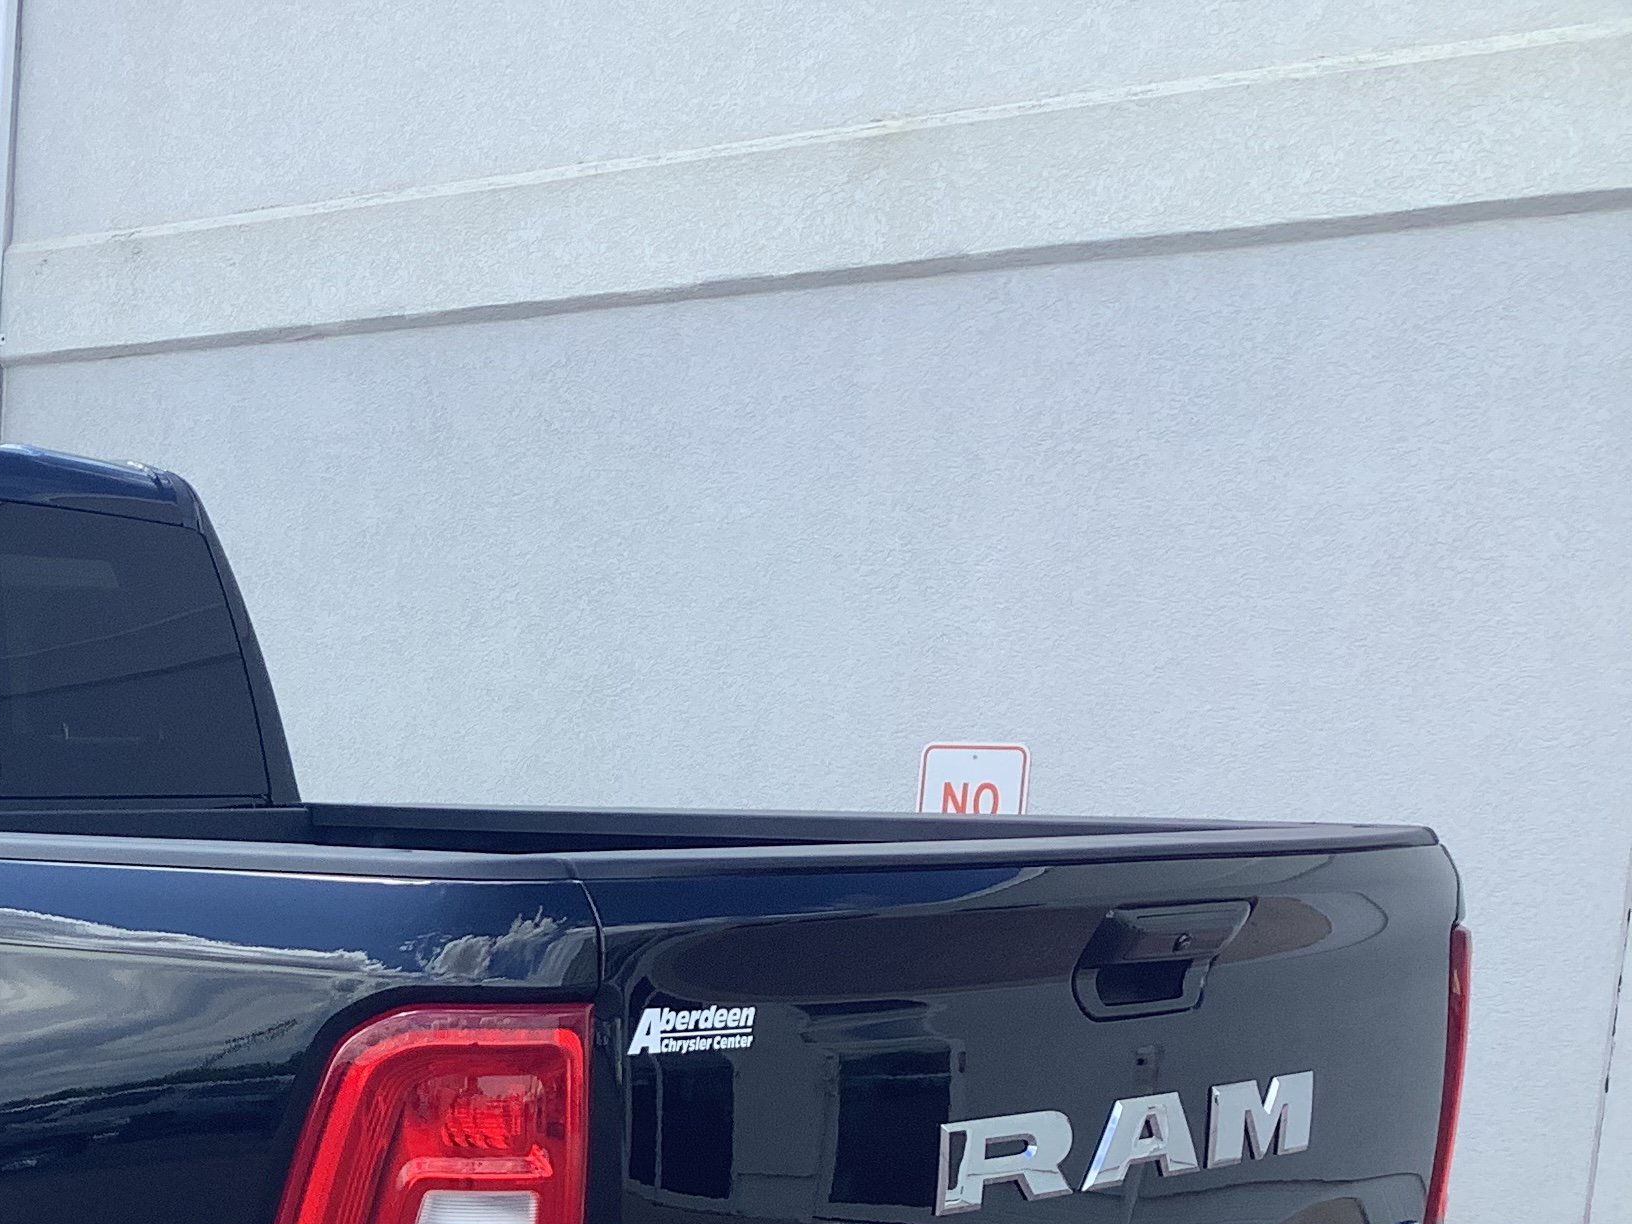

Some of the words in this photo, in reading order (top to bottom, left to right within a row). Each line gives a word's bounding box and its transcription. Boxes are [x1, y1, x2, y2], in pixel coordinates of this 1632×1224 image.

[941, 781, 1000, 815] NO
[626, 1005, 756, 1056] Aberdeen
[661, 1037, 712, 1054] Chrysler
[713, 1035, 754, 1051] Center
[934, 1070, 1314, 1216] RAM
